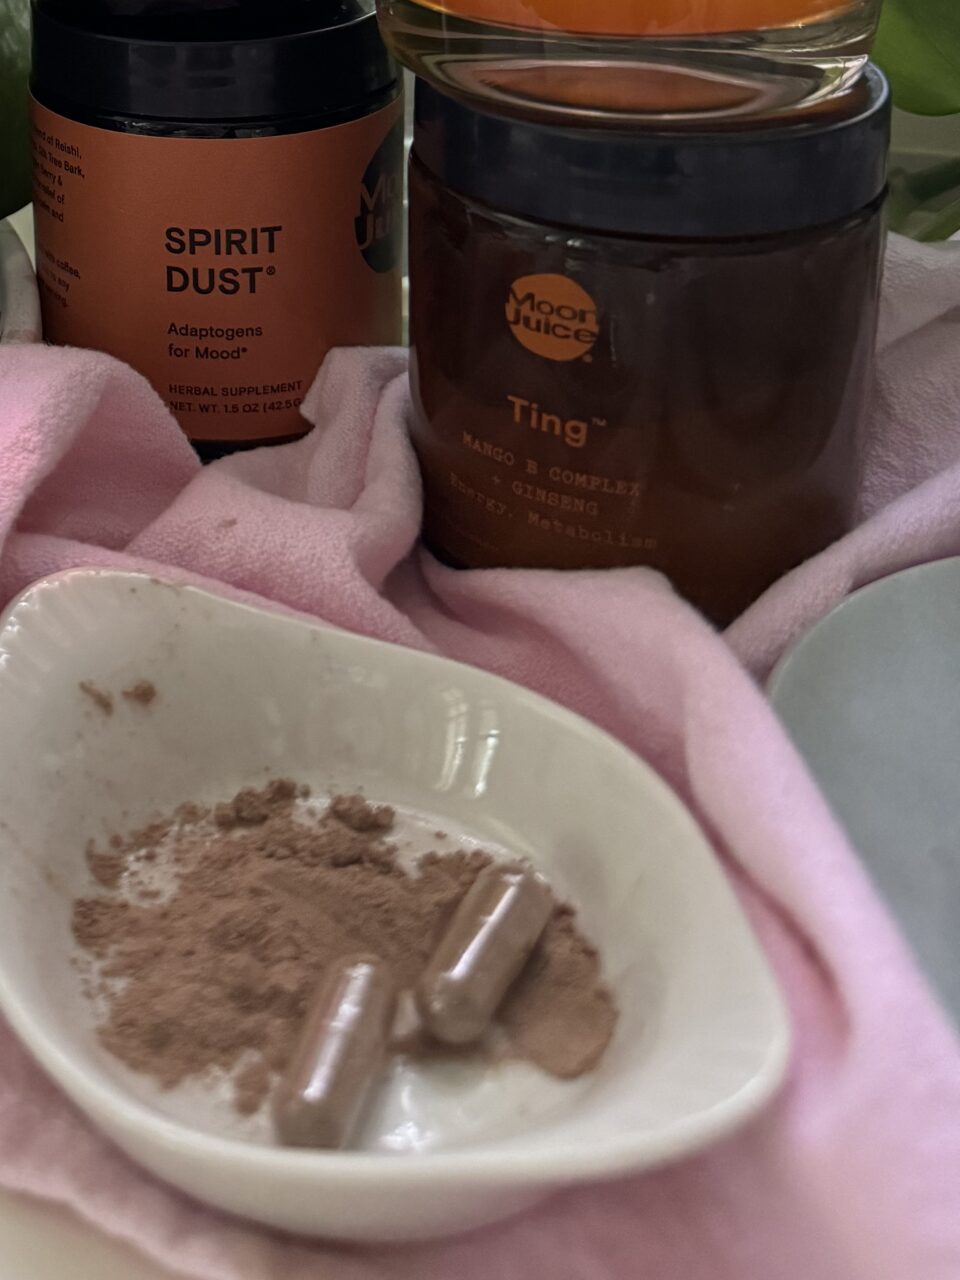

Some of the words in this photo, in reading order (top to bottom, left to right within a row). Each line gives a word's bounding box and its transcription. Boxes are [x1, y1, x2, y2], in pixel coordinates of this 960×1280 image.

[164, 225, 283, 256] SPIRIT
[510, 288, 598, 324] Moon
[167, 321, 263, 340] Adaptogens
[510, 306, 599, 344] Juice
[167, 343, 191, 358] for
[168, 383, 218, 397] HERBAL
[221, 380, 303, 397] SUPPLEMENT
[223, 404, 239, 414] 1.5
[242, 403, 260, 414] OZ
[462, 430, 515, 466] MANGO
[526, 460, 539, 475] B
[548, 466, 641, 498] COMPLEX
[512, 480, 599, 516] GINSENG
